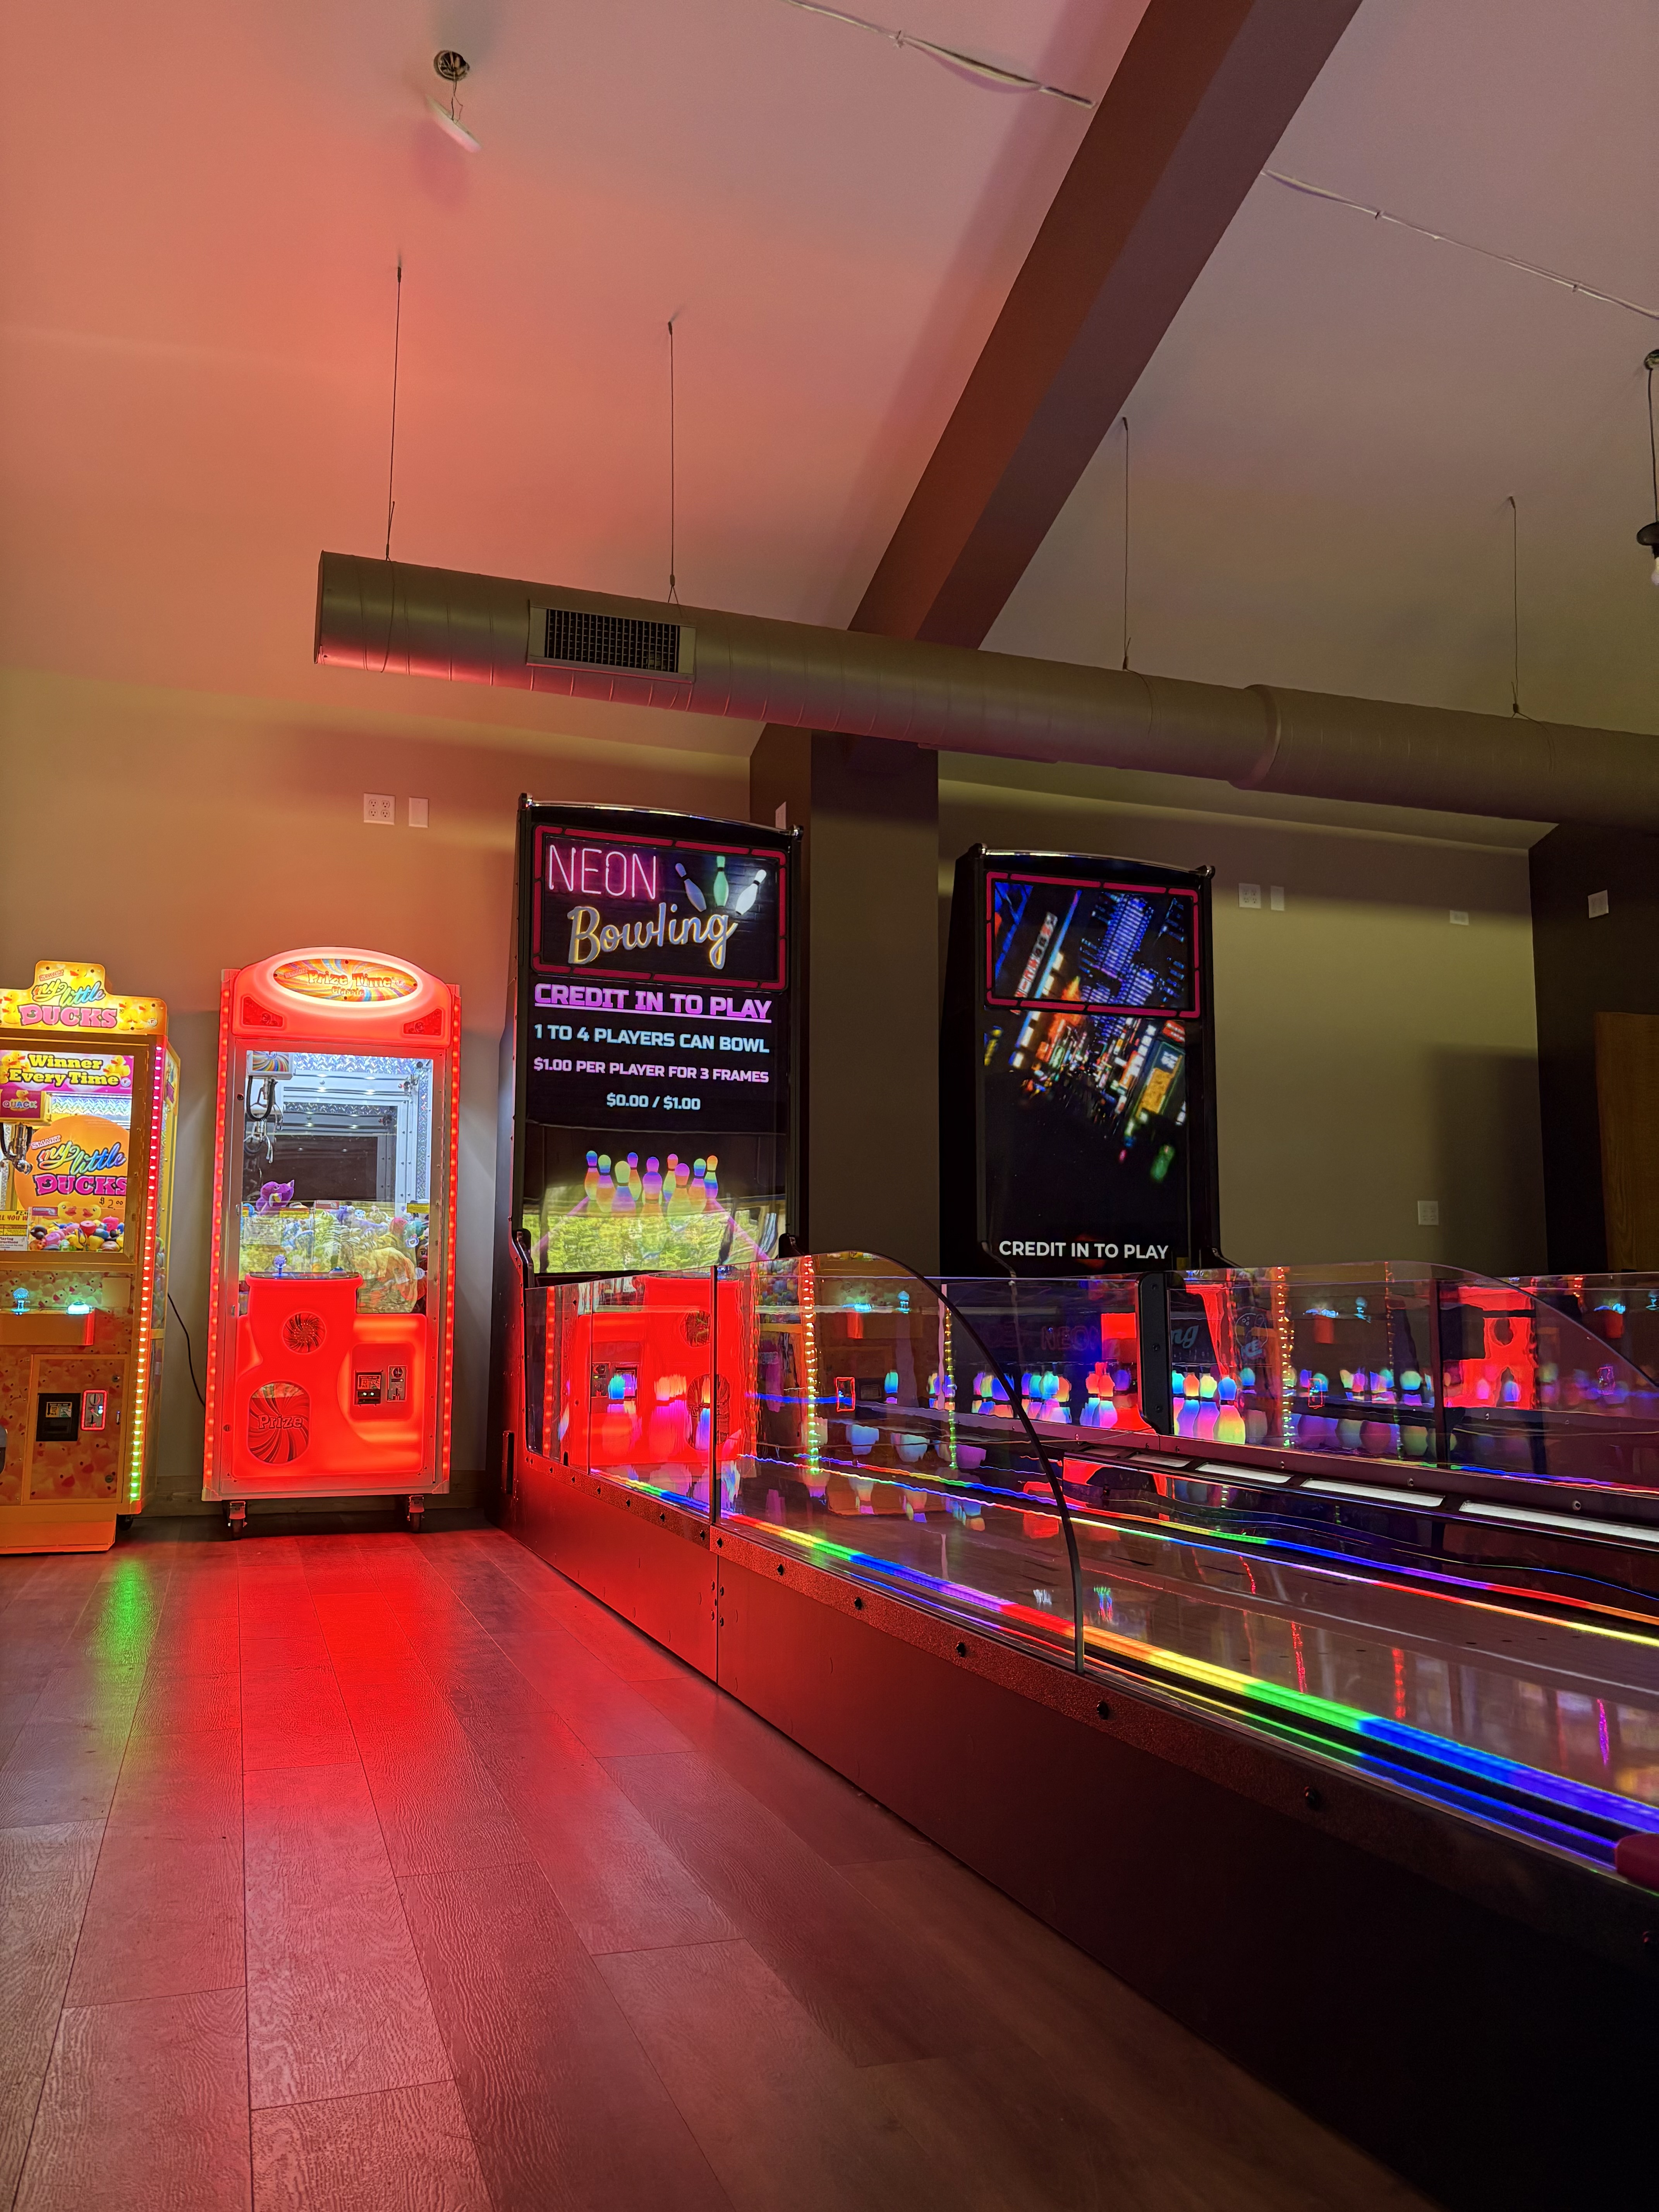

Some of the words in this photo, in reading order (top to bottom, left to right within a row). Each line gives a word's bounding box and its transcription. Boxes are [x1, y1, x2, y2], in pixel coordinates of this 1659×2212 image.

[549, 844, 657, 900] NEON
[567, 902, 738, 969] Bowling
[307, 970, 348, 986] Prize
[352, 973, 392, 988] Time
[32, 979, 68, 1003] my
[59, 981, 106, 1007] little
[535, 984, 629, 1010] CREDIT
[635, 991, 663, 1012] IN
[670, 993, 702, 1015] TO
[710, 996, 771, 1018] PLAY
[18, 1004, 117, 1028] DUCKS
[535, 1024, 542, 1038] 1
[548, 1025, 572, 1040] TO
[577, 1027, 589, 1041] 4
[595, 1028, 675, 1046] PLAYERS
[680, 1034, 714, 1049] CAN
[720, 1036, 769, 1053] BOWL
[27, 1054, 103, 1070] Winner
[534, 1057, 572, 1071] $1.00
[577, 1061, 605, 1073] PER
[610, 1063, 665, 1077] PLAYER
[669, 1066, 697, 1078] FOR
[700, 1068, 709, 1079] 3
[713, 1069, 769, 1082] FRAMES
[9, 1068, 67, 1087] Every
[68, 1071, 120, 1086] Time
[2, 1100, 38, 1109] QUACK
[607, 1092, 648, 1107] $0.00
[652, 1096, 660, 1108] /
[664, 1096, 700, 1109] $1.00
[31, 1135, 61, 1149] SMART
[37, 1140, 81, 1170] my
[69, 1142, 127, 1175] little
[33, 1173, 127, 1196] DUCKS
[1000, 1241, 1066, 1256] CREDIT
[1072, 1243, 1088, 1257] IN
[1094, 1244, 1118, 1257] TO
[1125, 1245, 1168, 1259] PLAY
[258, 1414, 303, 1430] Prize
